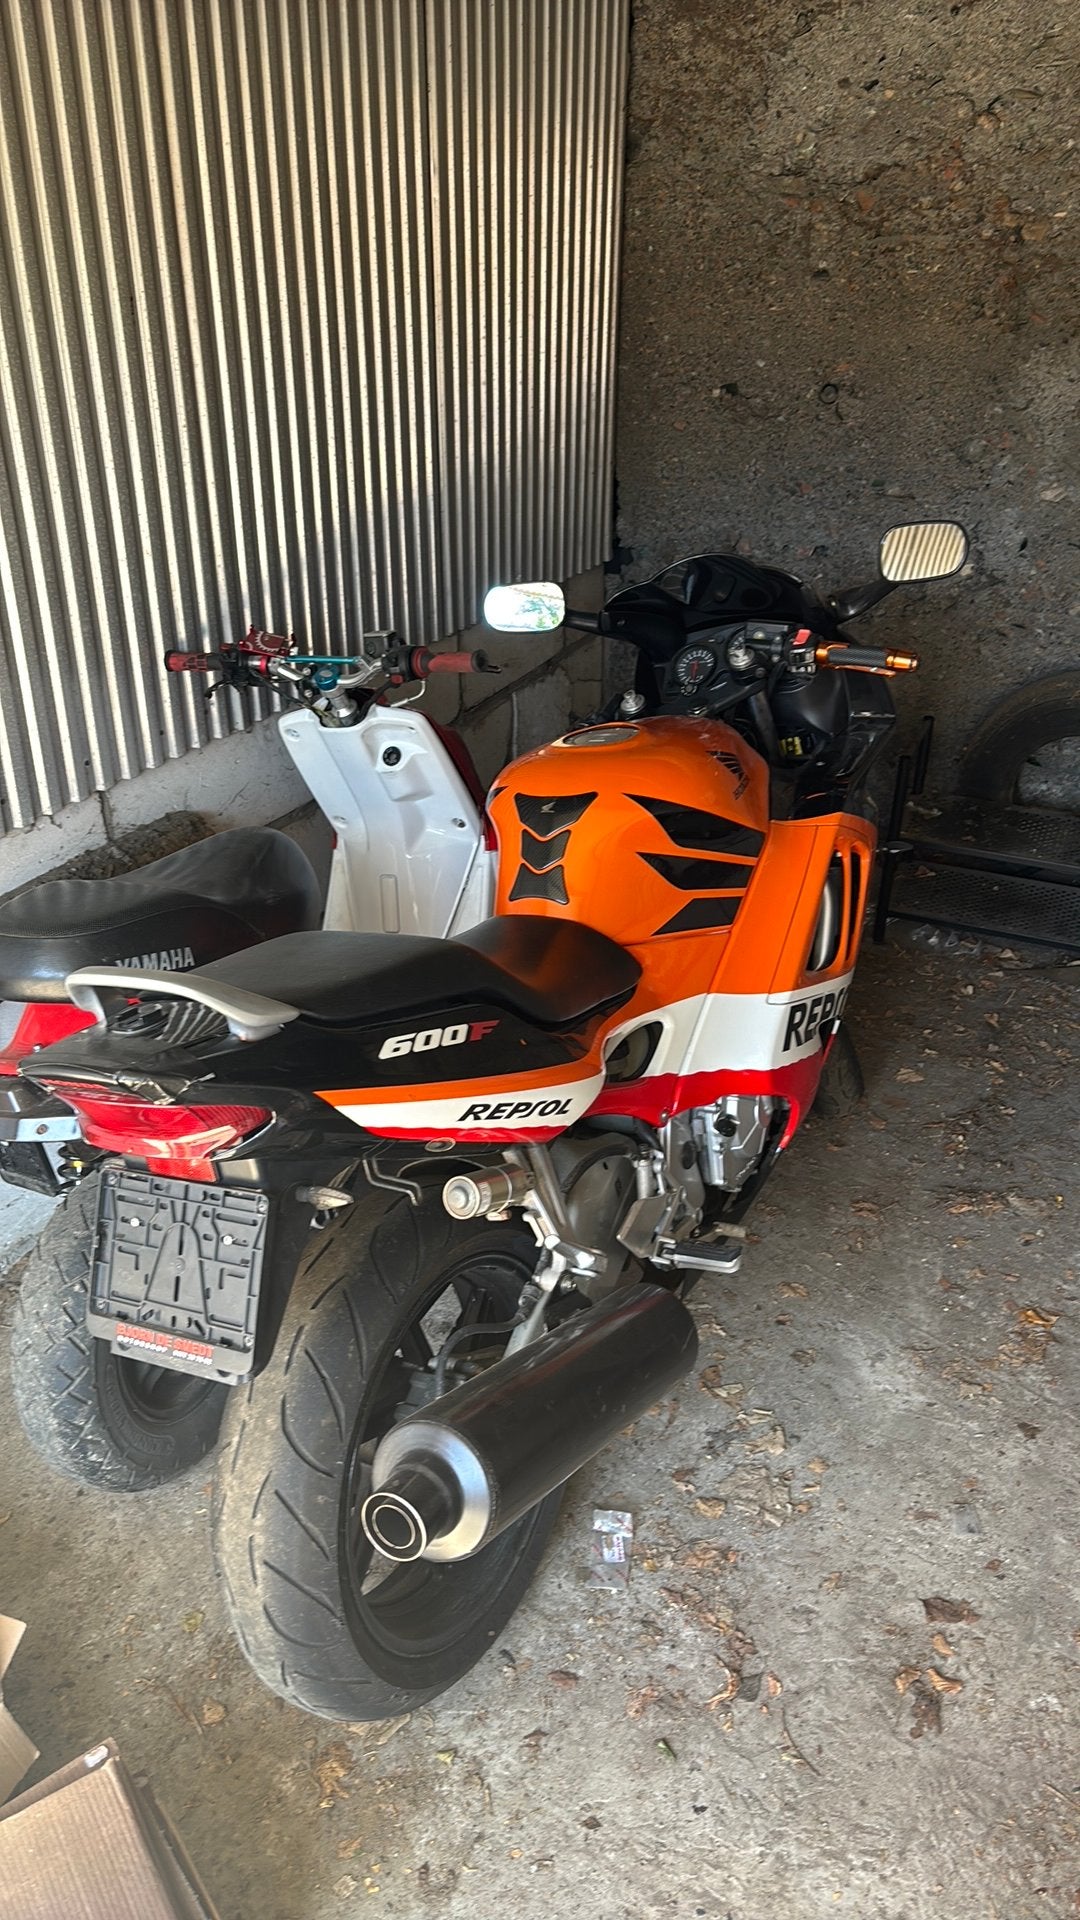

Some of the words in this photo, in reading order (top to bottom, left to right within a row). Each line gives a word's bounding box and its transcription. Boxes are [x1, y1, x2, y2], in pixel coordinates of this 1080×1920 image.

[114, 946, 195, 971] YAMAHA
[377, 1019, 500, 1060] 600F
[456, 1098, 573, 1122] REPSOL
